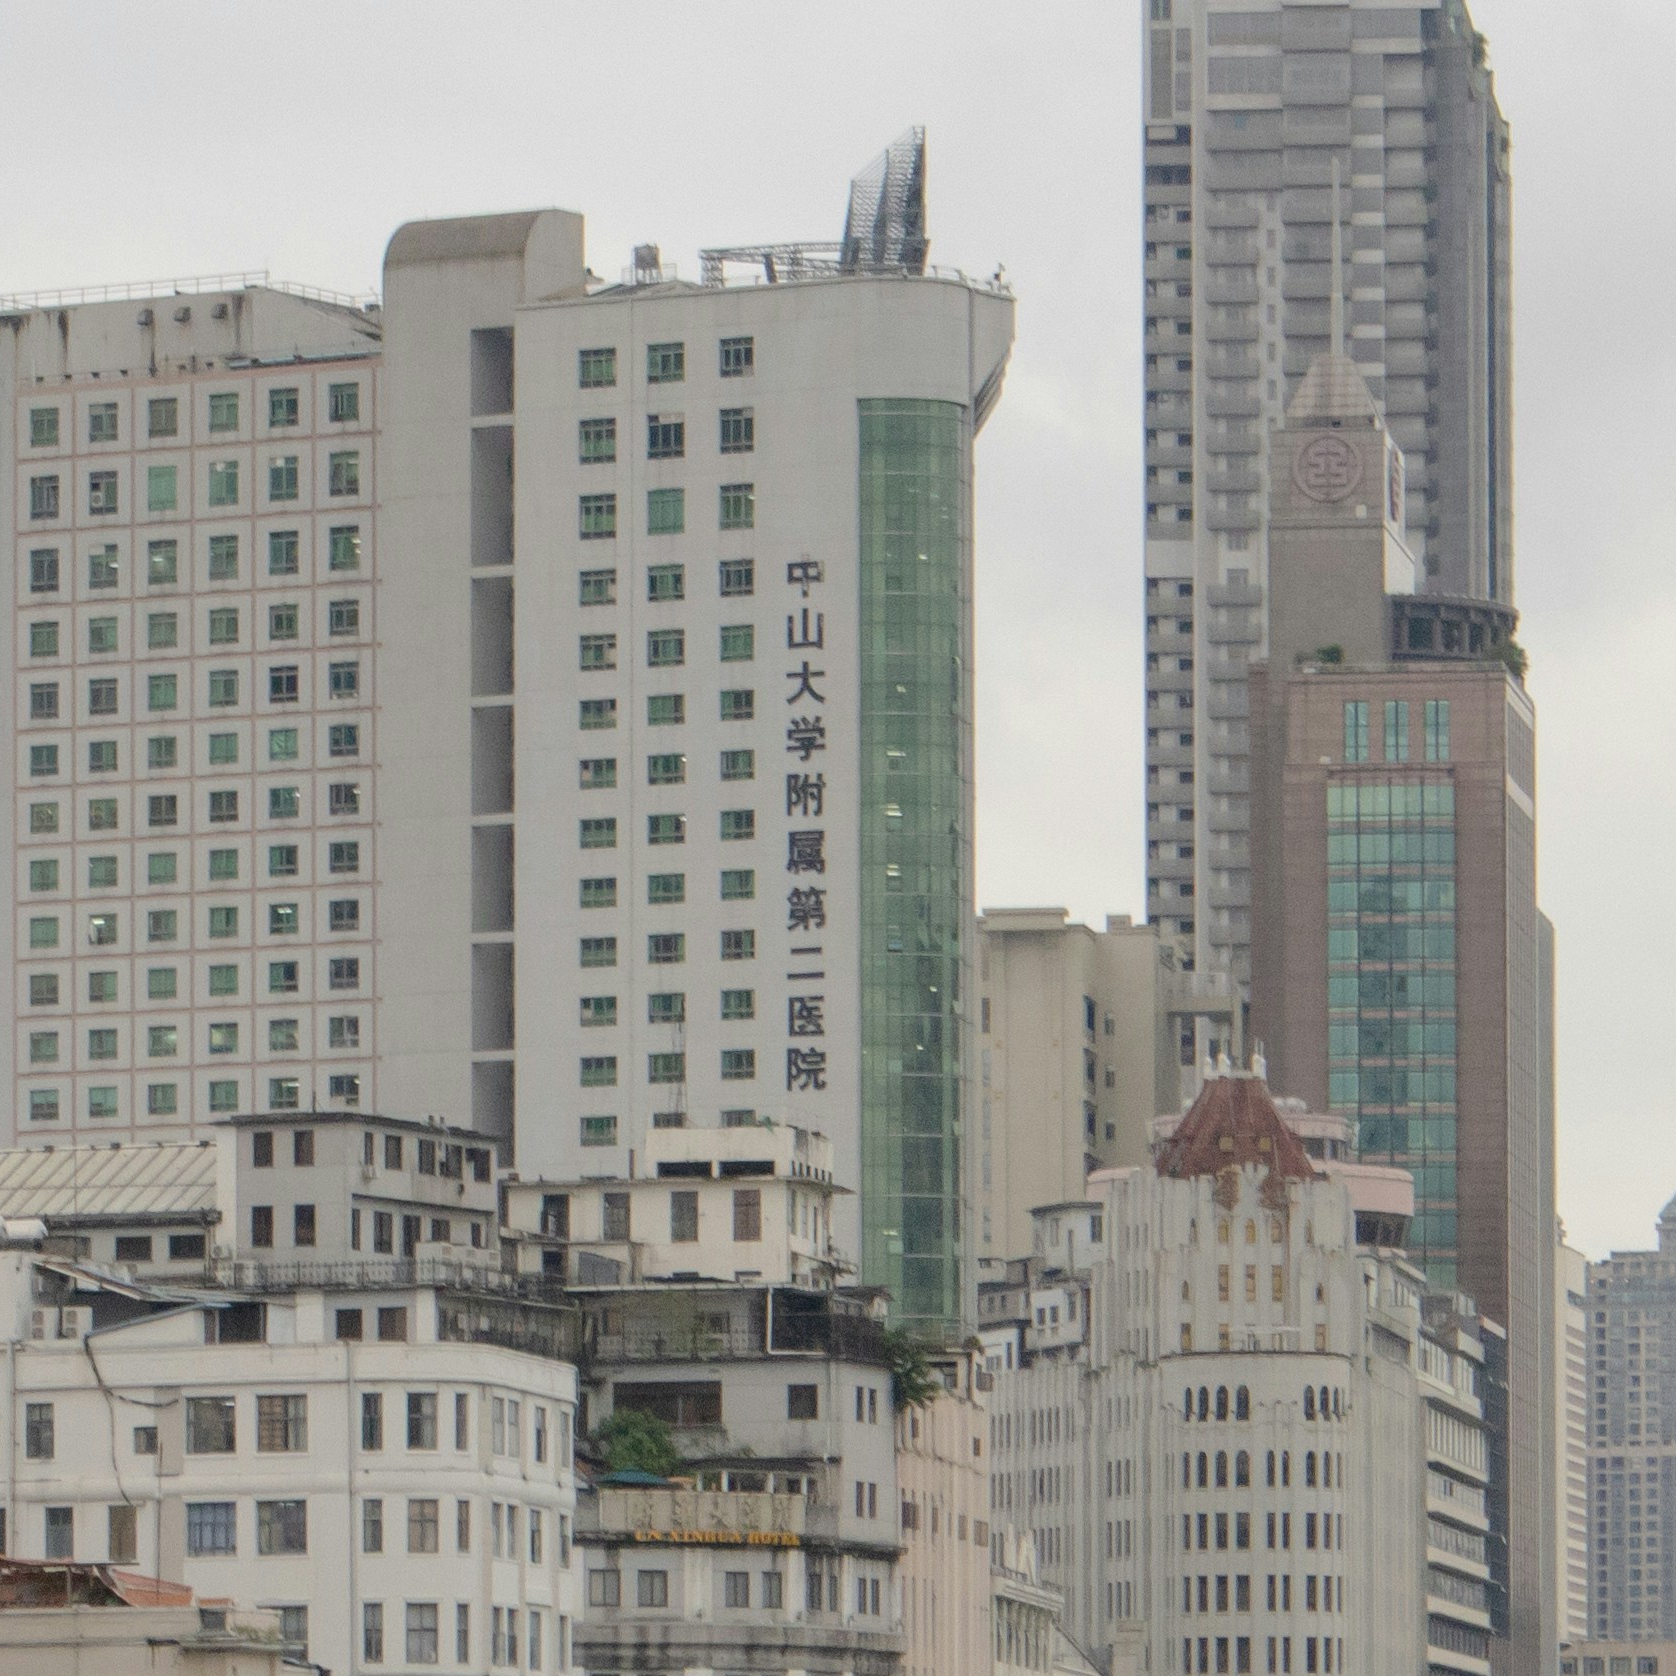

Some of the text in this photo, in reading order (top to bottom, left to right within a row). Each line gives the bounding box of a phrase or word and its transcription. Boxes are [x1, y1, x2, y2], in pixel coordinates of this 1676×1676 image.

[785, 559, 826, 1092] 中山大学附属第二医院
